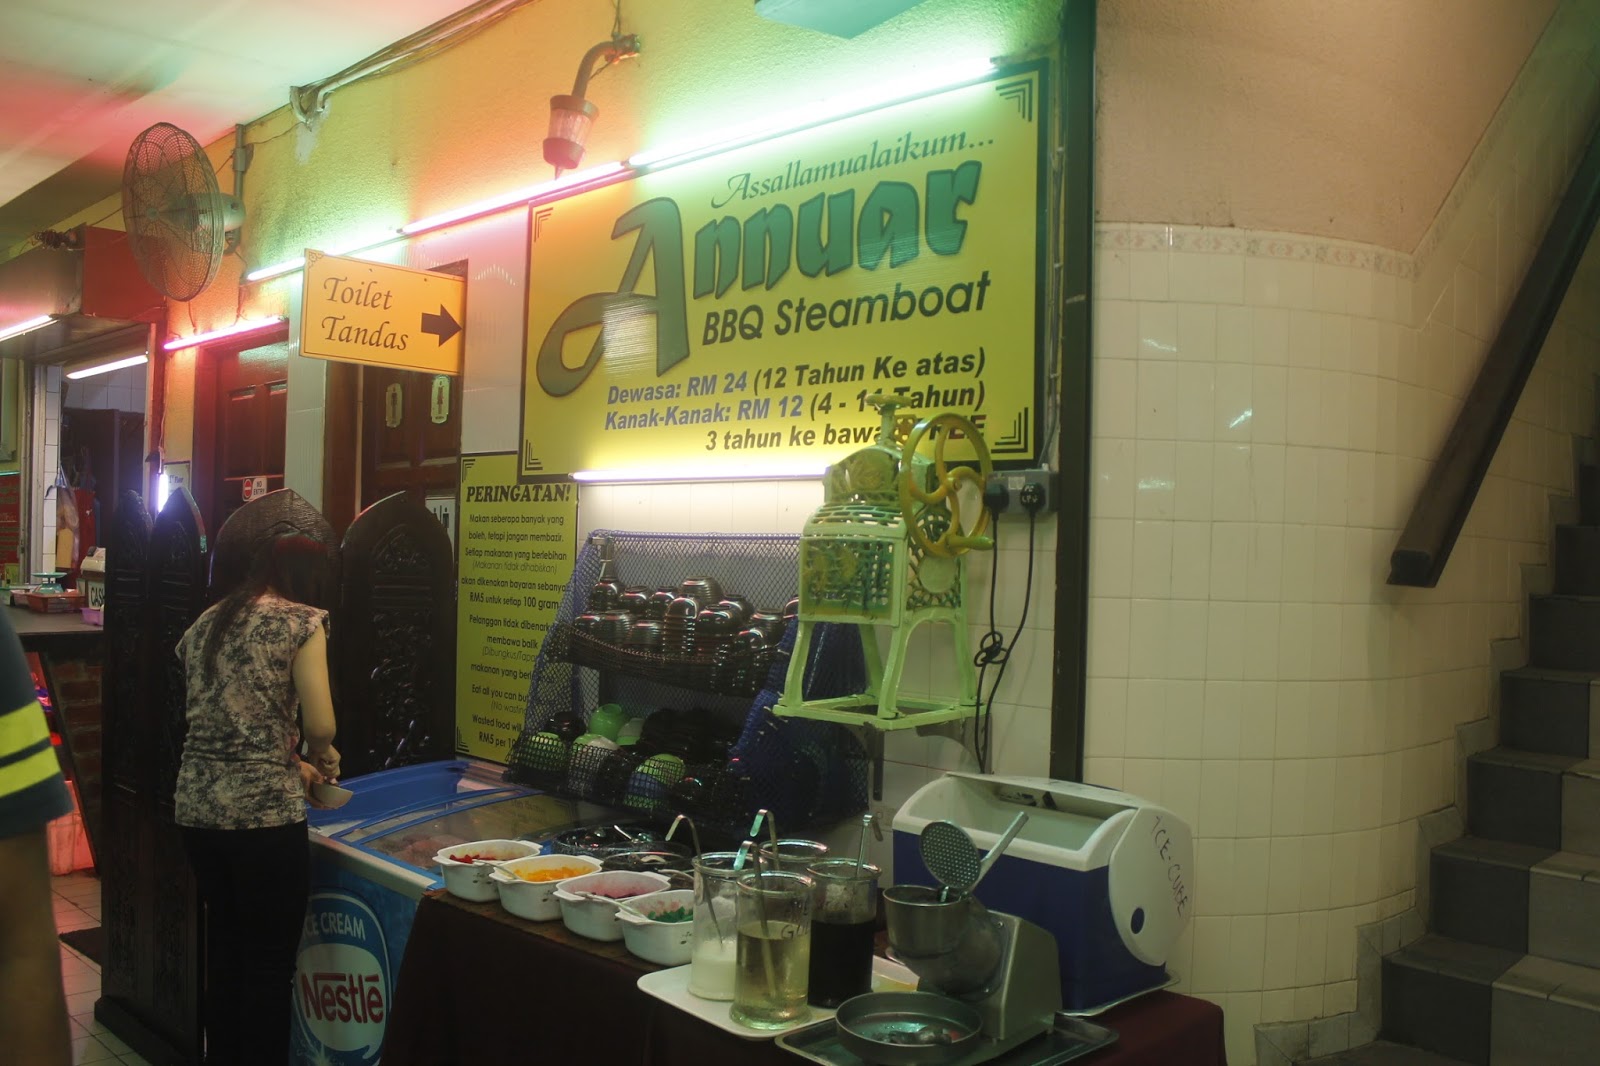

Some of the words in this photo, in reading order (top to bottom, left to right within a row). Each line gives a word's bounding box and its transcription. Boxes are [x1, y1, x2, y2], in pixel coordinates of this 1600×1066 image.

[711, 131, 994, 209] Assallamualaikum...
[536, 160, 983, 398] Annuar
[323, 276, 393, 311] Toilet
[702, 304, 765, 346] BBQ
[774, 270, 991, 336] Steamboat
[321, 315, 409, 351] Tandas
[607, 382, 682, 405] Dewasa:
[686, 374, 718, 398] RM
[723, 371, 748, 394] 24
[753, 366, 788, 396] (12
[795, 362, 865, 388] Tahun
[873, 355, 908, 380] Ke
[916, 346, 986, 379] atas)
[604, 402, 732, 431] Kanak-Kanak:
[736, 397, 772, 421] RM
[778, 395, 804, 418] 12
[810, 391, 832, 422] (4
[706, 430, 718, 451] 3
[724, 427, 783, 450] tahun
[789, 425, 817, 447] ke
[823, 423, 884, 445] bawa
[253, 488, 266, 496] ENTRY
[256, 480, 264, 488] NO
[465, 483, 572, 503] PERINGATAN!
[469, 514, 490, 523] Makan
[490, 514, 520, 525] seberapa
[521, 515, 545, 526] banyak
[547, 516, 564, 526] yang
[468, 530, 487, 541] boleh,
[488, 531, 506, 542] tetapi
[506, 531, 529, 543] jangan
[465, 547, 483, 558] Setiap
[484, 548, 513, 558] makanan
[514, 550, 530, 562] yang
[531, 550, 567, 561] berlebihan
[472, 560, 503, 571] (Makanan
[504, 561, 519, 571] tidak
[520, 563, 557, 575] dihabiskan)
[461, 576, 475, 586] akan
[477, 576, 508, 588] dikenakan
[509, 579, 537, 591] bayaran
[537, 581, 567, 593] sebanya
[469, 591, 484, 603] RM5
[485, 593, 502, 604] untuk
[502, 596, 521, 607] setiap
[523, 596, 537, 608] 100
[469, 614, 502, 628] Pelanggan
[503, 618, 519, 629] tidak
[487, 635, 521, 647] membawa
[521, 638, 538, 649] balik
[470, 663, 500, 674] makanan
[501, 668, 518, 680] yang
[471, 683, 482, 693] Eat
[482, 686, 490, 695] all
[491, 688, 503, 698] you
[503, 691, 517, 700] can
[472, 713, 495, 727] Wasted
[496, 718, 510, 730] food
[479, 730, 495, 745] RM5
[495, 738, 506, 748] per
[320, 911, 366, 941] CREAM
[301, 972, 384, 1025] Nestlé
